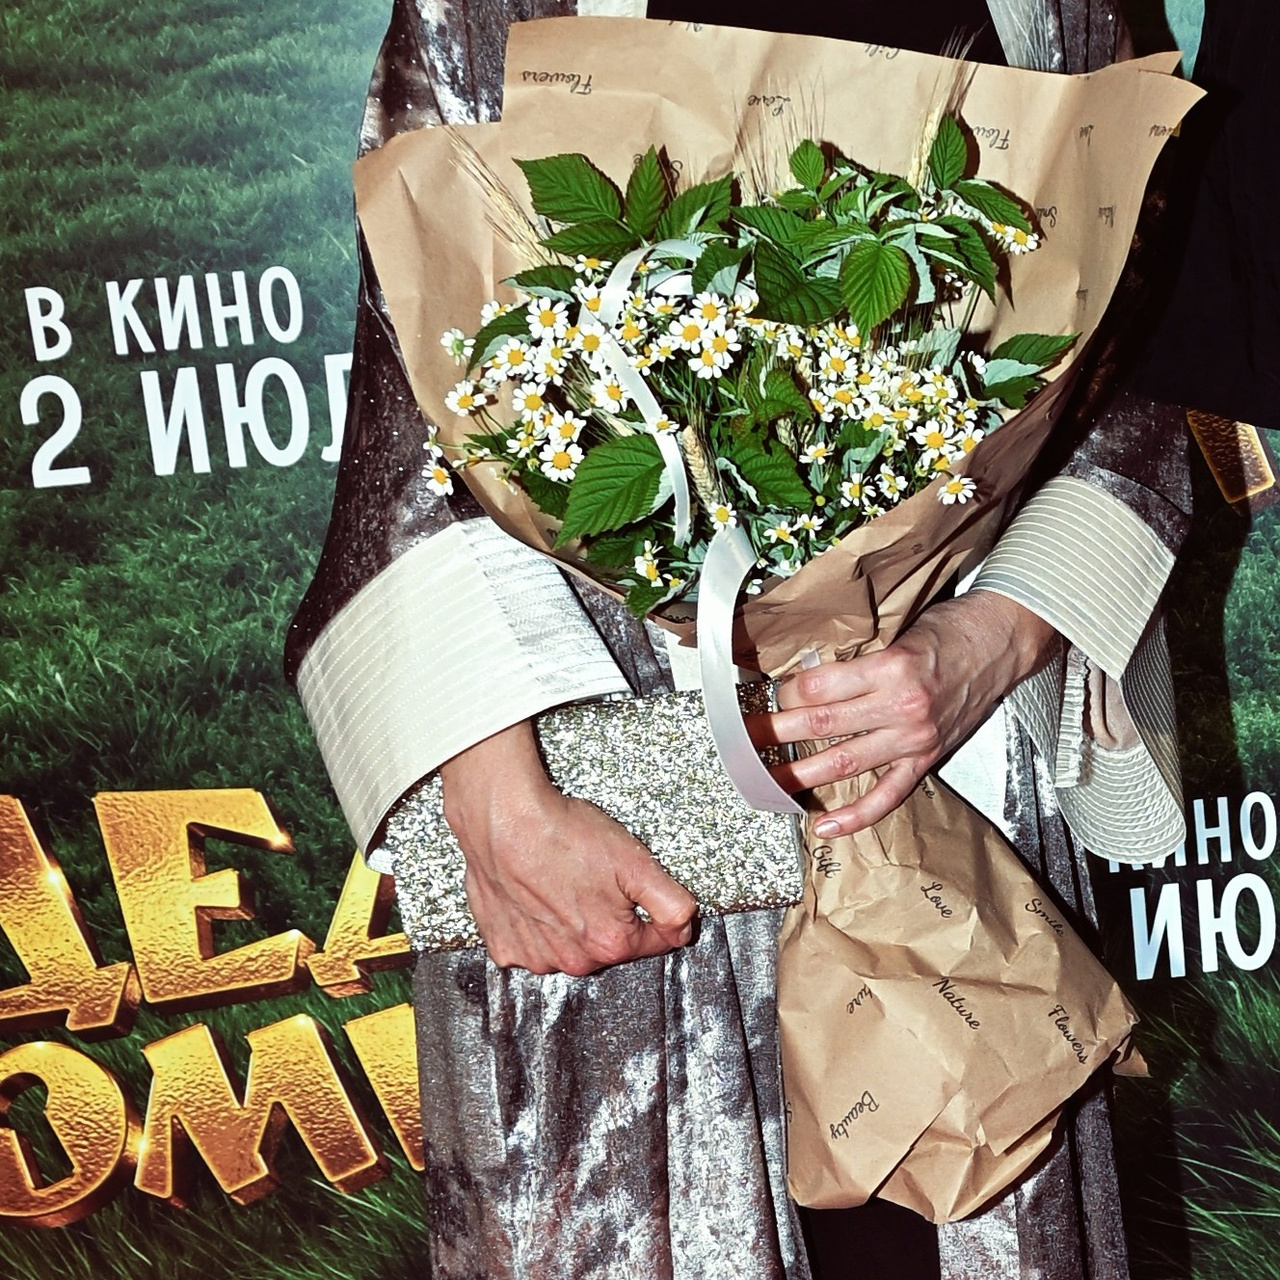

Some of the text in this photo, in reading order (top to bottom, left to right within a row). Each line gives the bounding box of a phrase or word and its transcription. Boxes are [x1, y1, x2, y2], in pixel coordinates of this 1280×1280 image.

[520, 69, 593, 95] Flowers
[24, 266, 303, 362] В КИНО
[19, 353, 353, 489] 2 ИЮЛ
[812, 845, 842, 879] Gift
[920, 881, 952, 919] Love
[1024, 897, 1066, 938] Smile
[932, 977, 981, 1030] Nature
[1047, 1003, 1089, 1065] Flowers
[829, 1089, 880, 1141] Beauty
